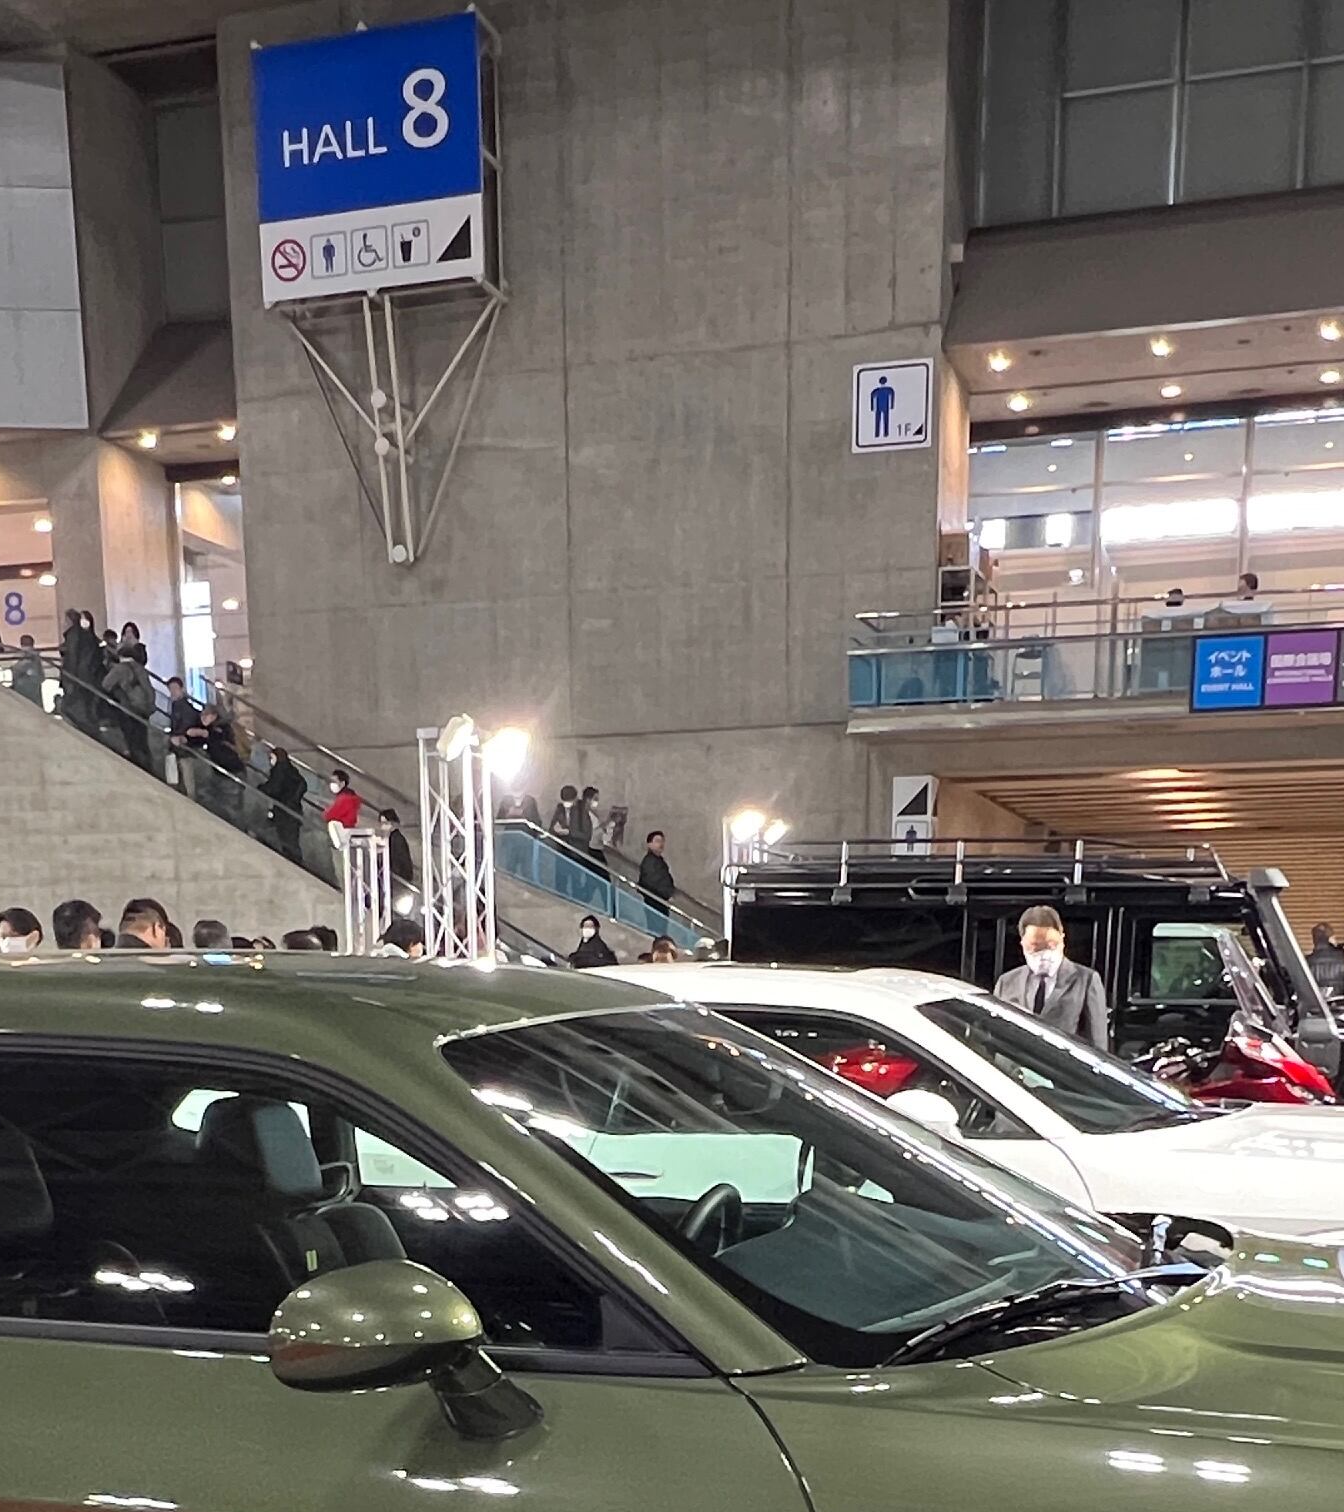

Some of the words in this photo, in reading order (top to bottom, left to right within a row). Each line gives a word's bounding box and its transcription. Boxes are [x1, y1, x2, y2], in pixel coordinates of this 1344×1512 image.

[282, 117, 388, 168] HALL
[402, 67, 449, 148] 8
[896, 422, 912, 437] 1F
[4, 591, 26, 626] 8
[1208, 649, 1252, 664] イベント
[1209, 664, 1248, 678] ホール
